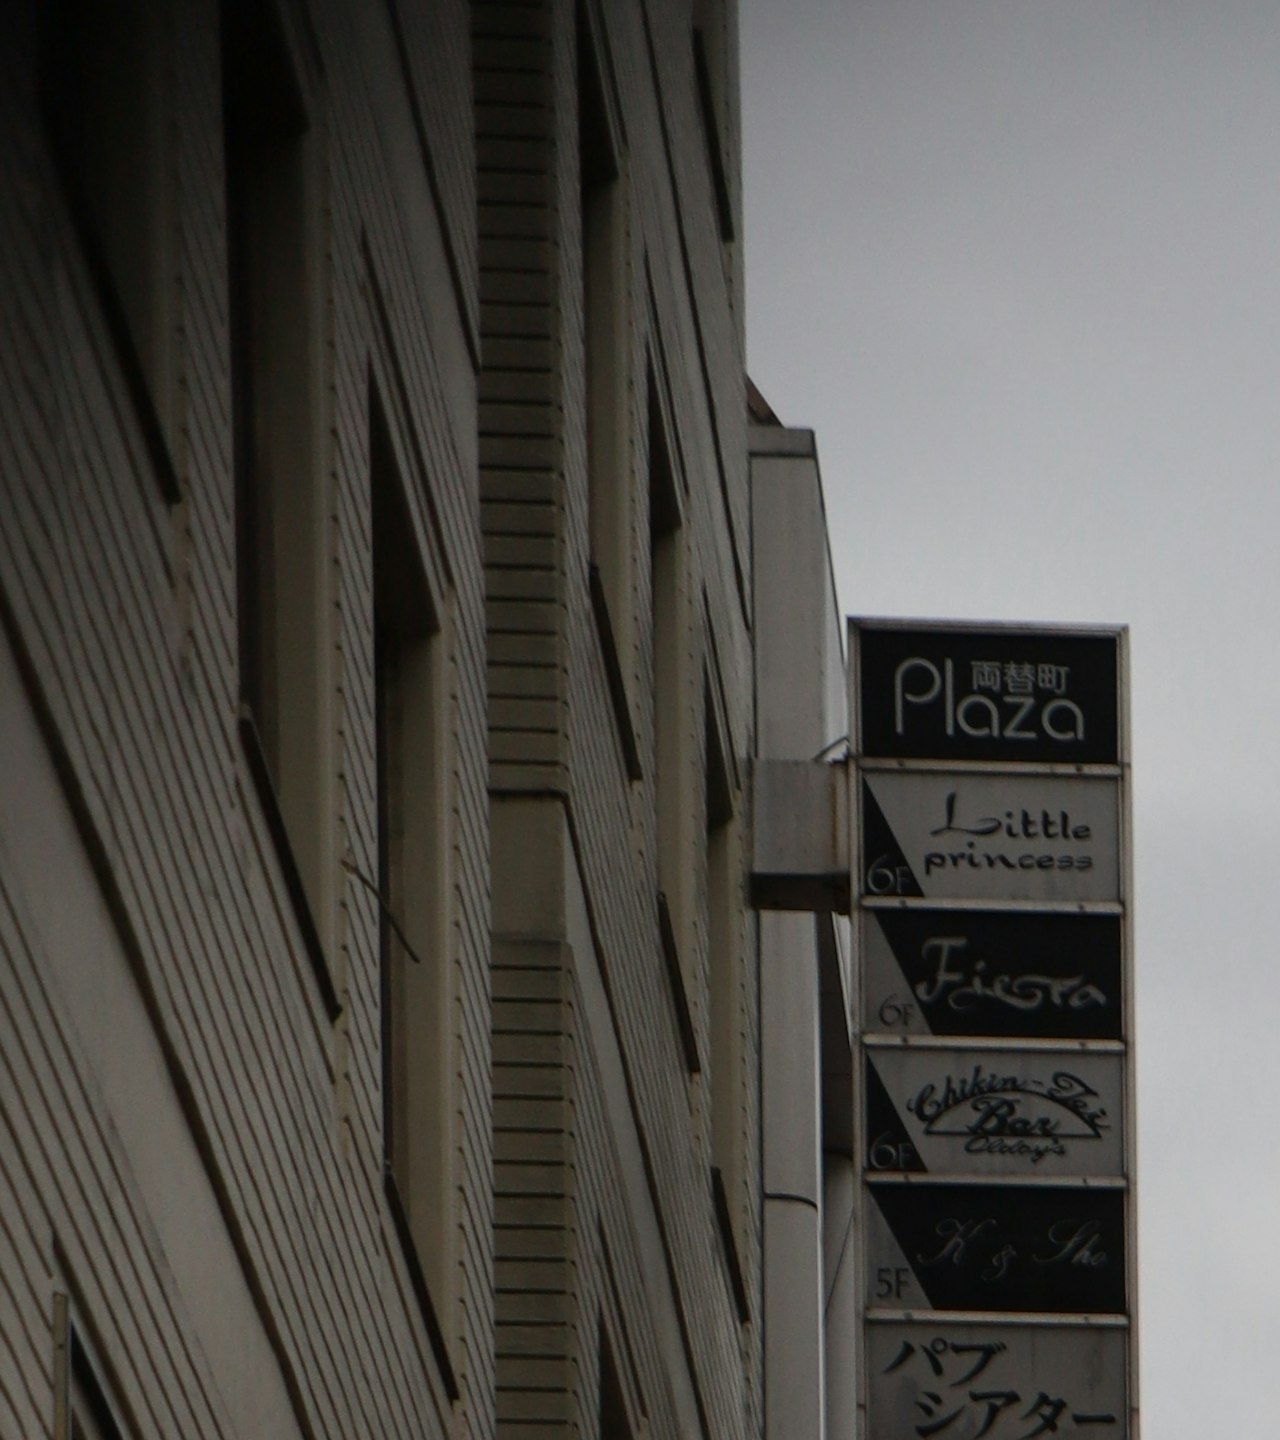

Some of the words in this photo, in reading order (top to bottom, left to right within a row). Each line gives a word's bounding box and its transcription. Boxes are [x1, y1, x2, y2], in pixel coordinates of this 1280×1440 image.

[969, 659, 1071, 695] 両替町
[893, 656, 1086, 742] Plaza
[930, 792, 1092, 840] Little
[867, 854, 910, 895] 6F
[924, 839, 1093, 876] princess
[879, 993, 915, 1028] 6F
[968, 1097, 1060, 1138] Bar
[869, 1130, 912, 1171] 6F
[876, 1267, 910, 1299] 5F
[882, 1337, 1008, 1389] パブ
[914, 1390, 1117, 1440] シアター
